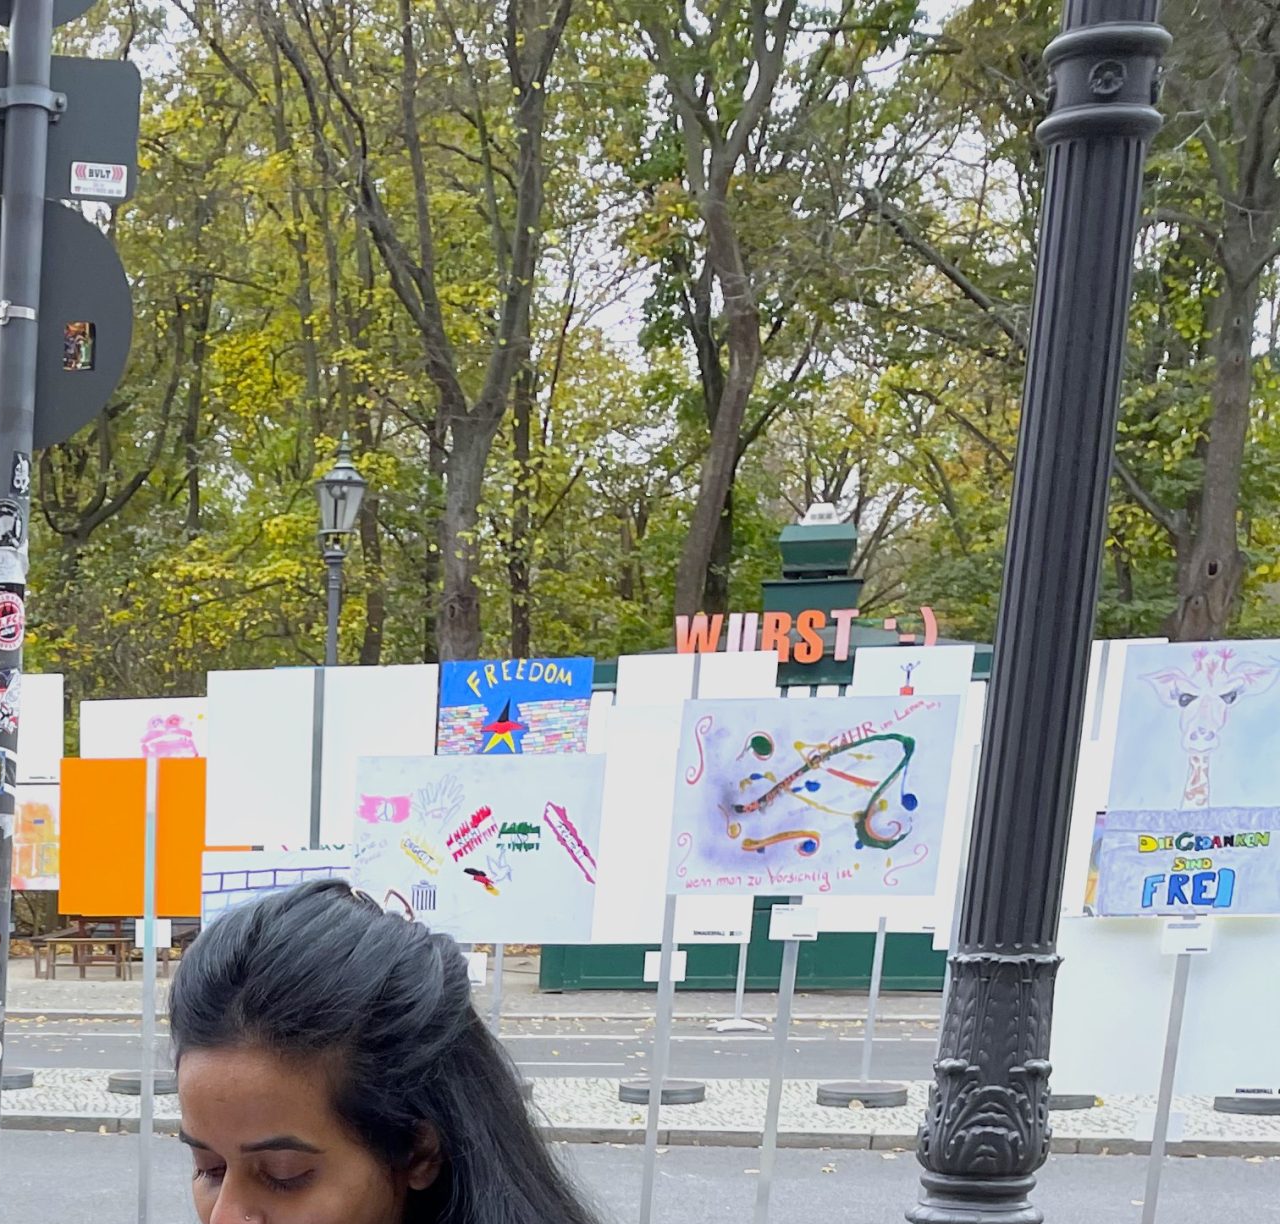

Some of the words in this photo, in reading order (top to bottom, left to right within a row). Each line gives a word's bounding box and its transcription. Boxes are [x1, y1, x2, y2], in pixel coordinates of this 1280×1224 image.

[676, 609, 859, 664] WURST
[467, 658, 573, 698] FREEDOM
[1175, 832, 1270, 852] GEDANKEN
[1142, 868, 1236, 908] FREI
